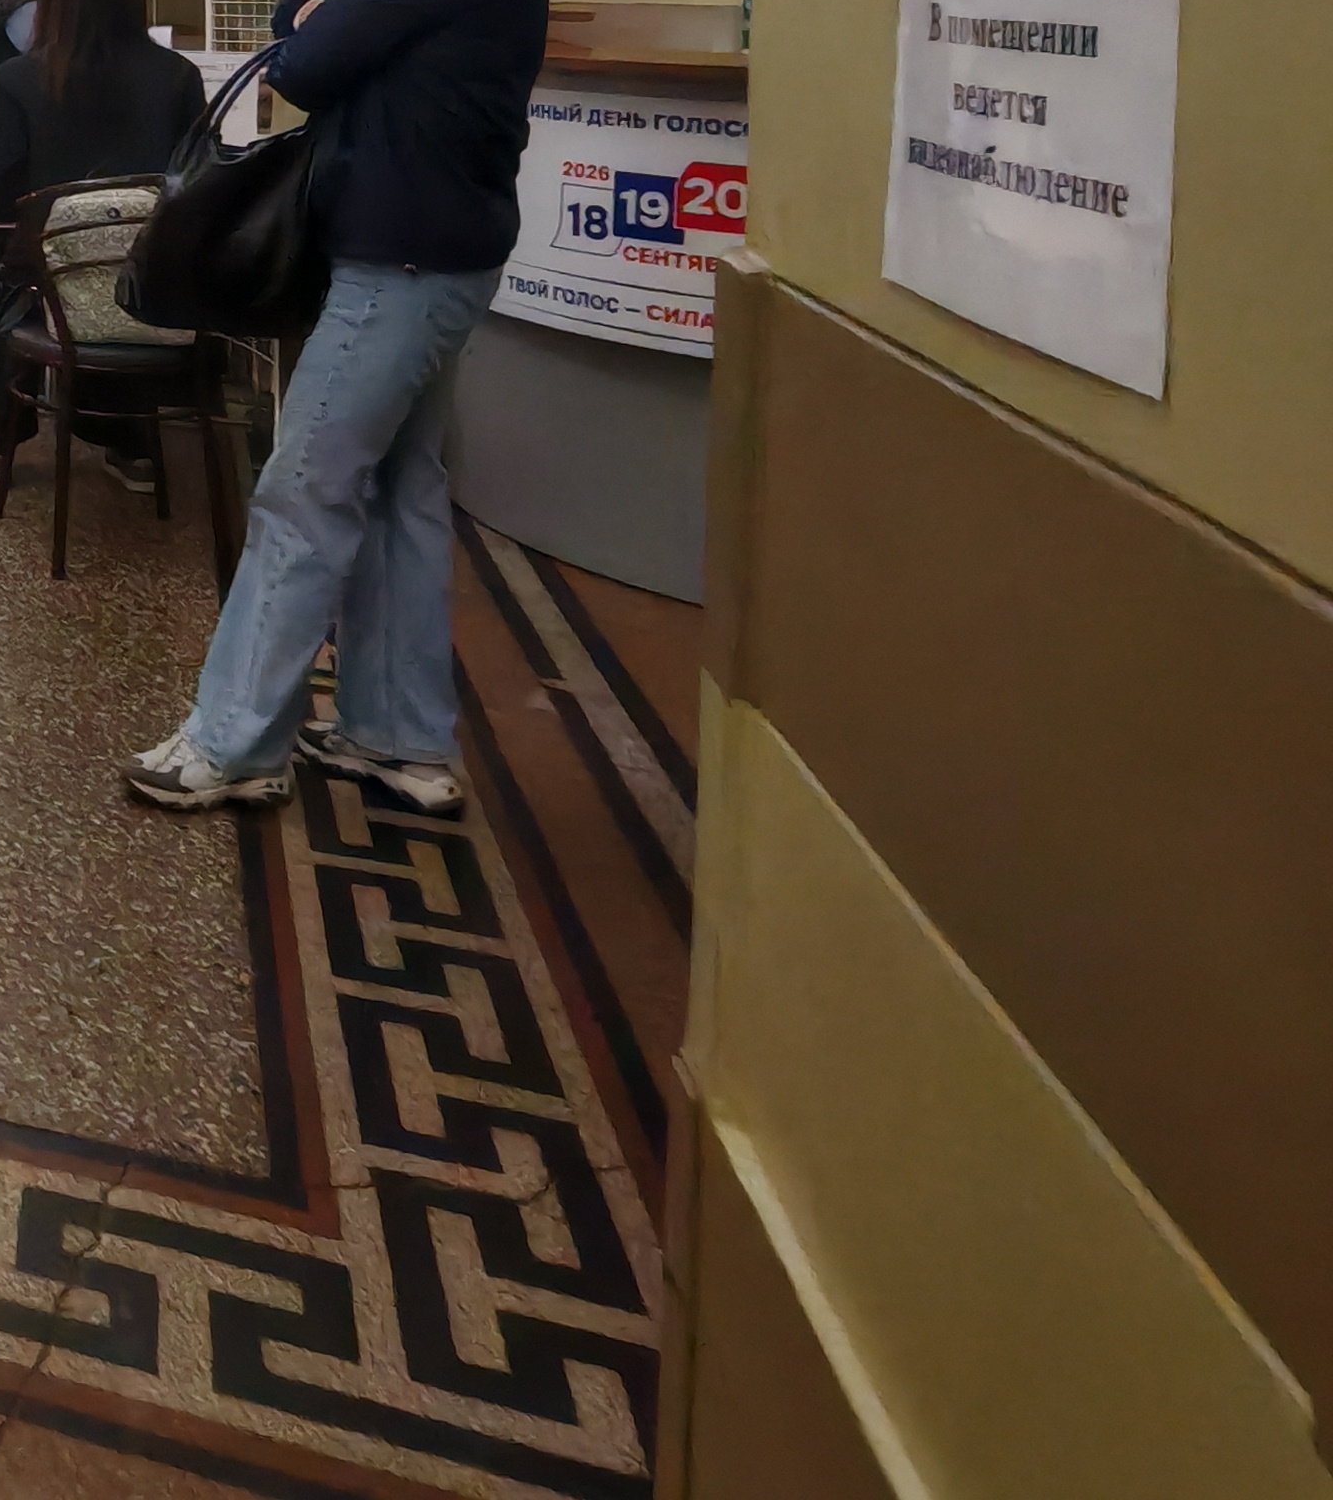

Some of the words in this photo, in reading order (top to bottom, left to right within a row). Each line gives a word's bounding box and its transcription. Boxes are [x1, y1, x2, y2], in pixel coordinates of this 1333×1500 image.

[928, 2, 942, 42] В
[586, 108, 647, 130] ДЕНЬ
[561, 160, 611, 182] 2026
[567, 201, 609, 241] 18
[618, 187, 671, 229] 19
[682, 176, 748, 220] 20
[507, 274, 549, 298] ТВОЙ
[552, 285, 620, 314] ГОЛОС
[645, 303, 715, 329] СИЛА
